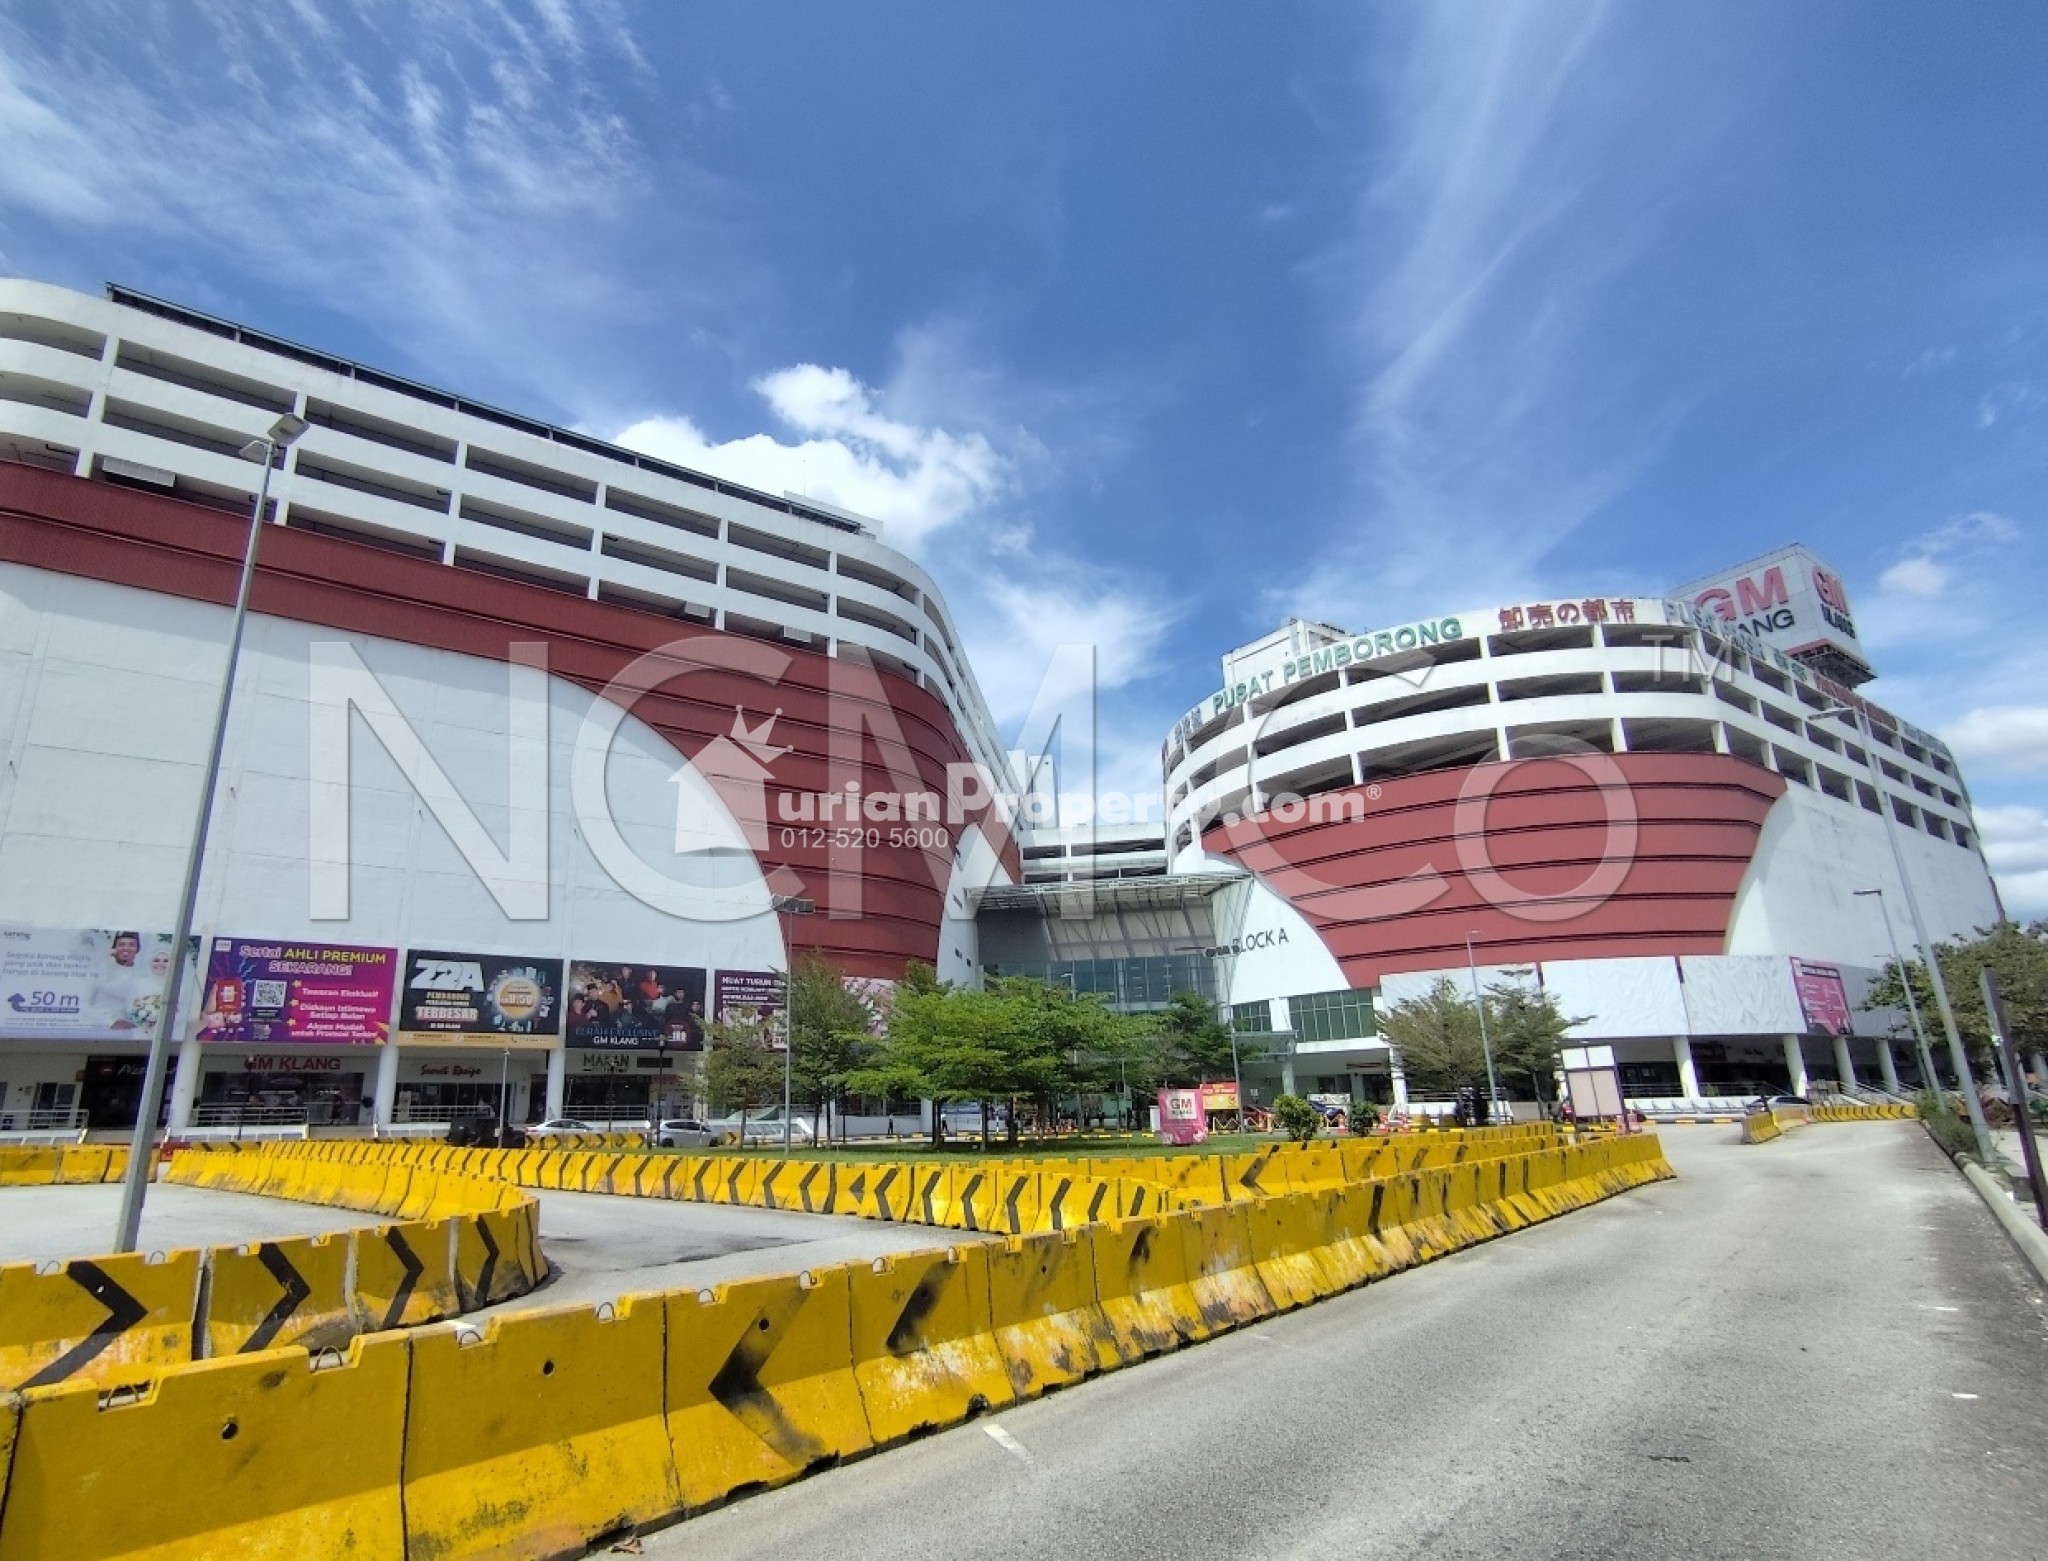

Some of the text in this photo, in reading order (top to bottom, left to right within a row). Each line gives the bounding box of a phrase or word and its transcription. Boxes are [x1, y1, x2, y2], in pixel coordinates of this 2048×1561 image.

[1694, 566, 1790, 621] GM
[1736, 607, 1796, 640] ANG
[1213, 616, 1463, 713] PUSAT PEMBORONG
[1278, 926, 1290, 945] A
[283, 948, 318, 959] AHLI
[322, 951, 387, 964] PREMIUM
[31, 991, 80, 1007] 50 m
[415, 1006, 479, 1019] TERBESAR
[279, 1055, 341, 1072] KLANG
[1169, 1098, 1193, 1109] GM
